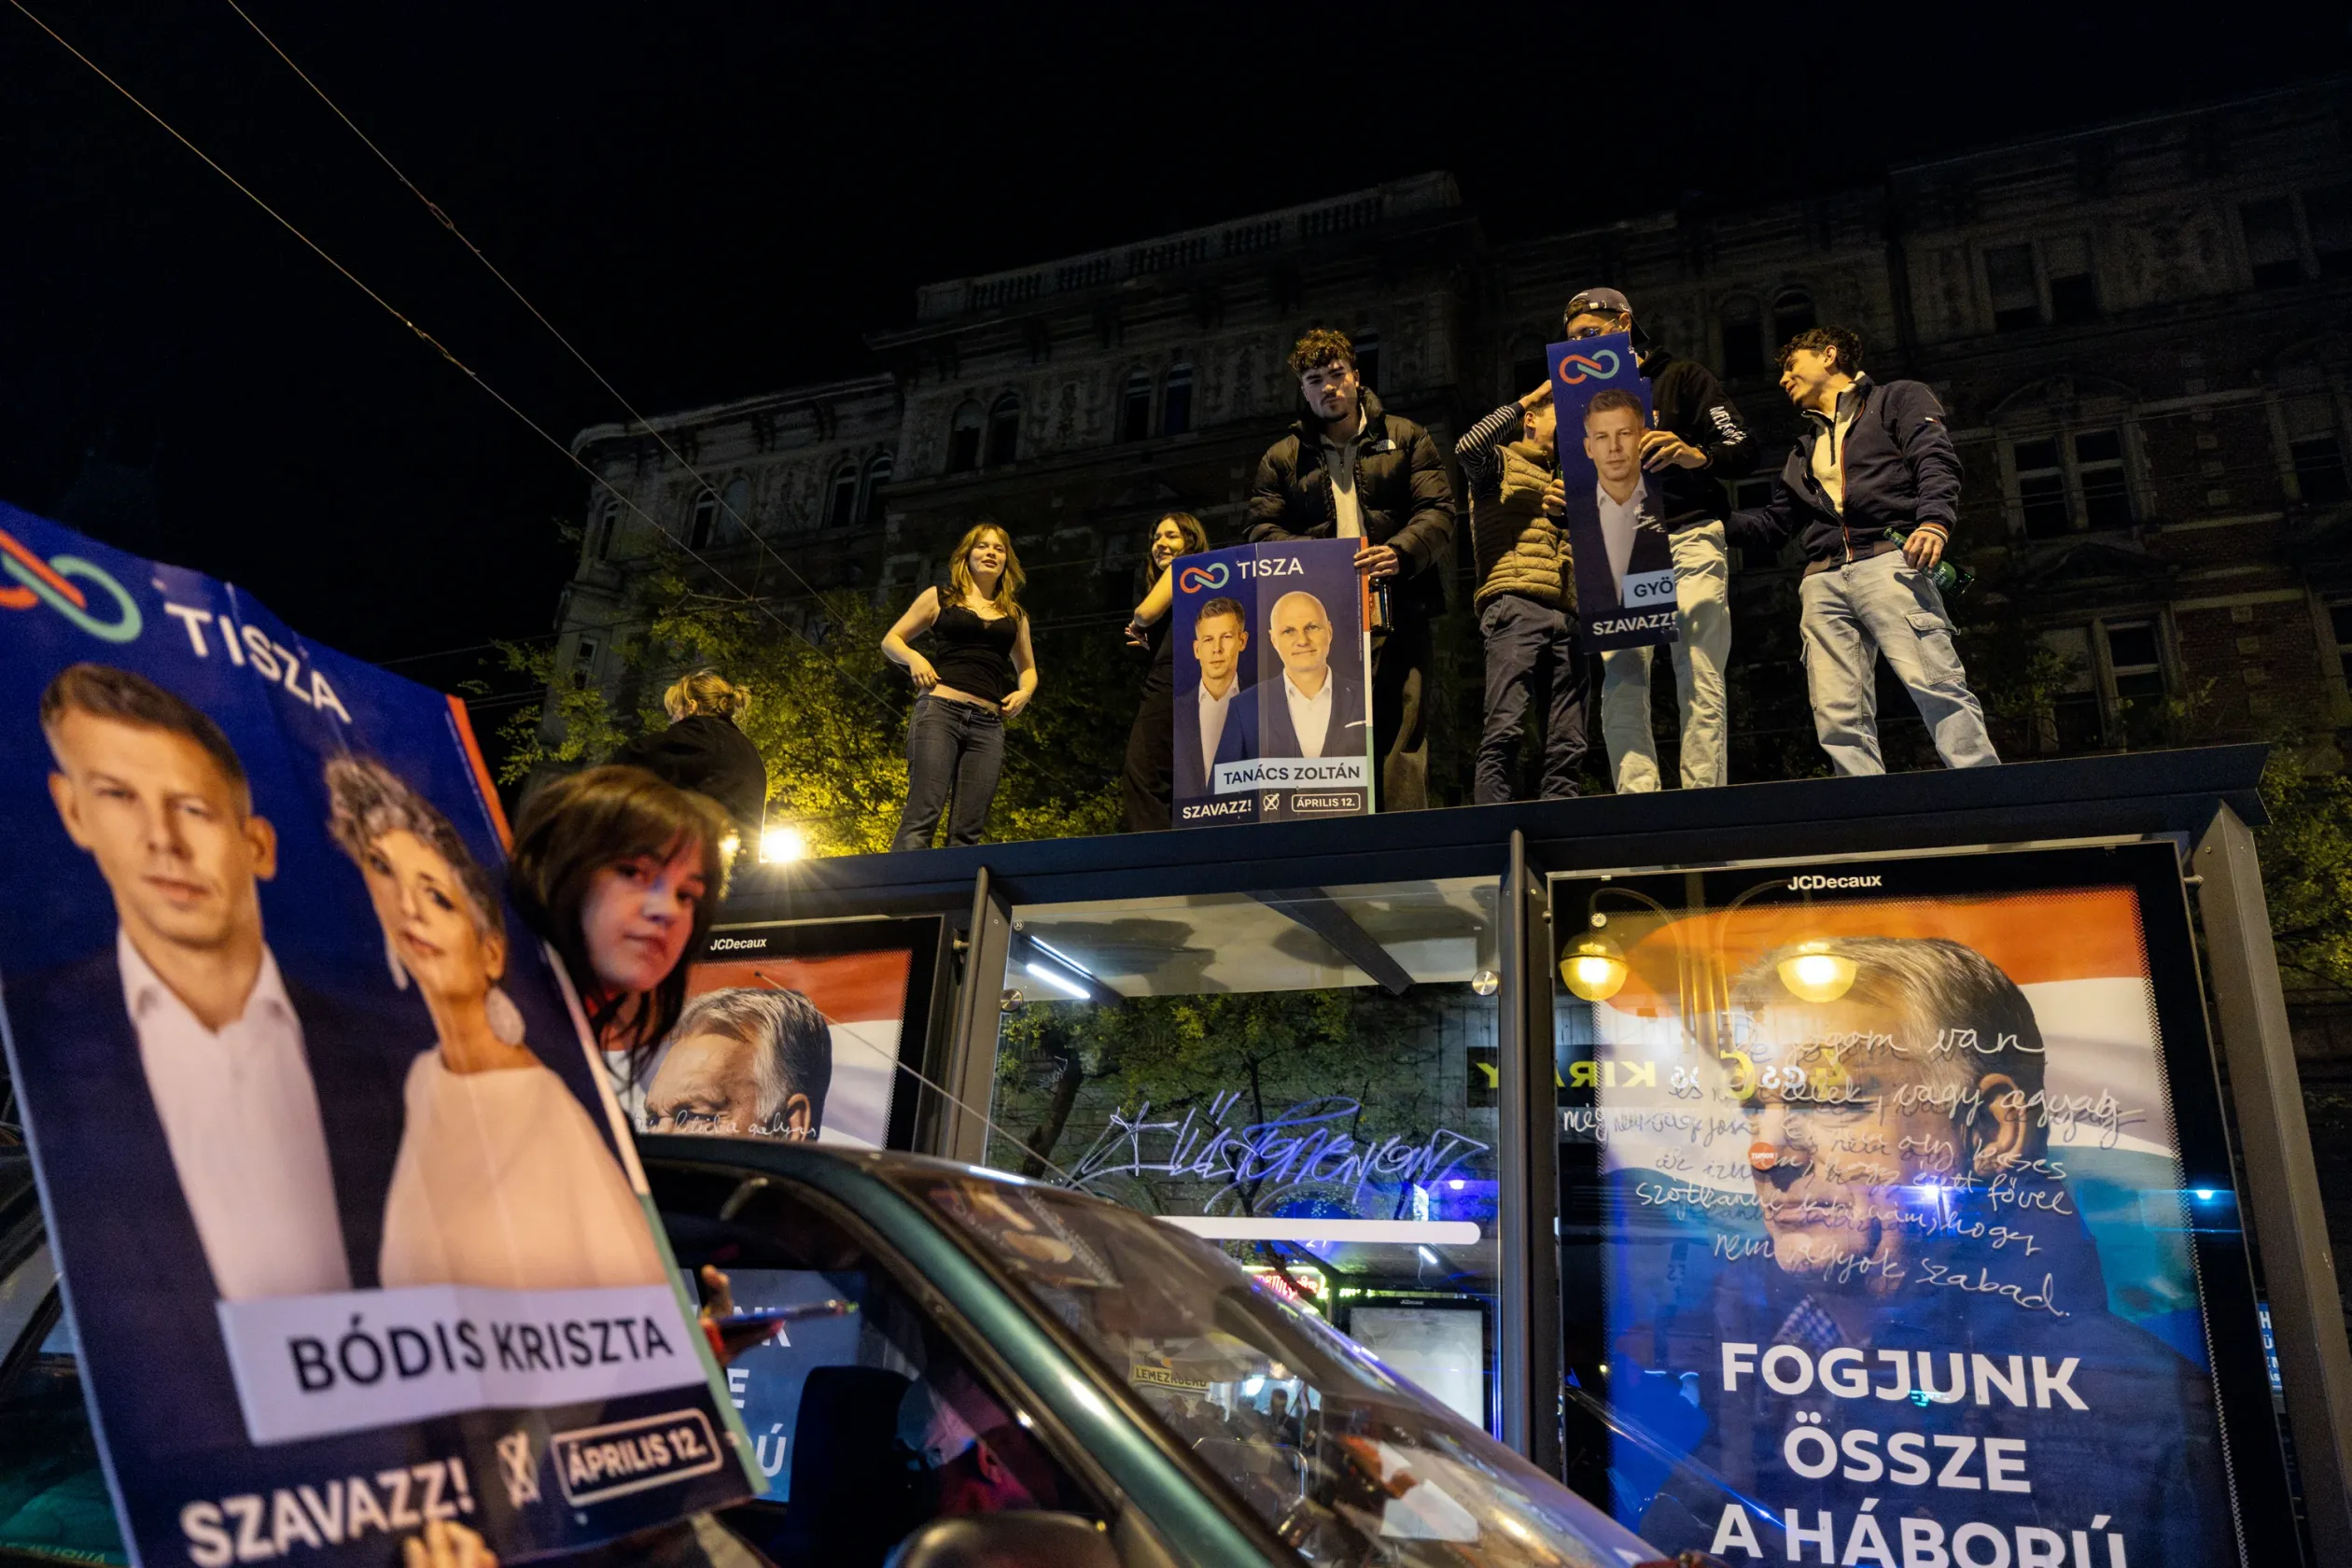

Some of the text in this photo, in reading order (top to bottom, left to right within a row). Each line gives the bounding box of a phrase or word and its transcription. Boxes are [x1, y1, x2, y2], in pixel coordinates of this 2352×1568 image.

[1239, 557, 1304, 579] TISZA
[1634, 576, 1673, 597] GYÖ
[164, 602, 352, 724] TISZA
[1224, 763, 1360, 785] TANÁCS ZOLTÁN
[1182, 797, 1356, 819] SZAVAZZ! ÁPRILIS 12.
[1787, 875, 1883, 890] JCDecaux
[710, 938, 767, 951] JCDecaux
[1927, 1027, 2046, 1055] van
[1893, 1081, 1984, 1127] vagy
[1713, 1232, 1776, 1262] nem
[287, 1313, 486, 1393] BÓDIS
[490, 1316, 675, 1373] KRISZTA
[1721, 1342, 2090, 1410] FOGJUNK
[1784, 1410, 2031, 1493] ÖSSZE
[179, 1456, 476, 1568] SZAVAZZ!
[568, 1434, 672, 1486] ÁPRILIS
[668, 1426, 707, 1462] 12.
[1710, 1497, 2127, 1568] A HÁBORÚ
